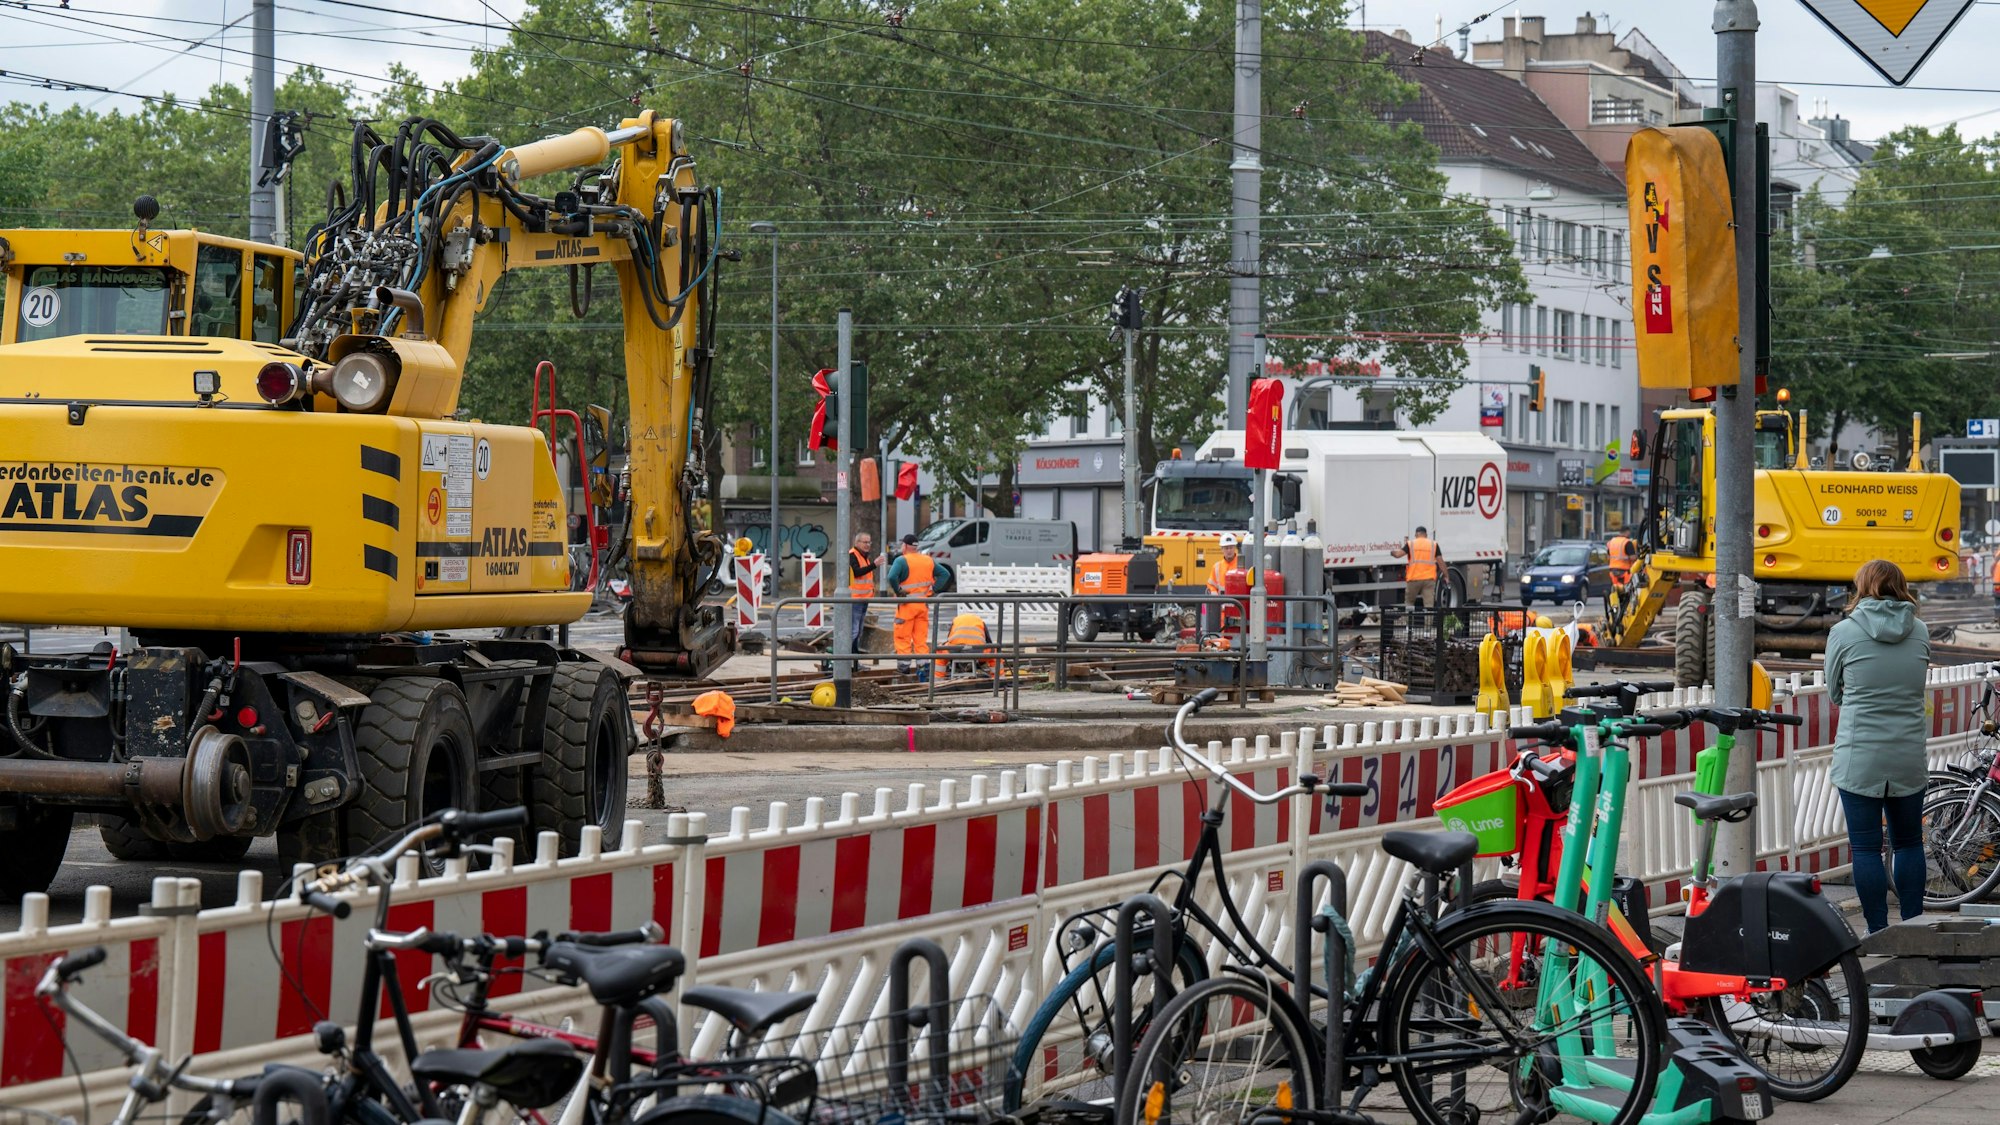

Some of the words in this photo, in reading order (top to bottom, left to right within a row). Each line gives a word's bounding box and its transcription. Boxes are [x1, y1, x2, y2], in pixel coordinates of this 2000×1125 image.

[555, 239, 582, 259] ATLAS
[38, 272, 77, 283] ATLAS
[82, 273, 158, 284] HANNOVER
[29, 294, 53, 319] 20
[478, 445, 489, 473] 20
[1441, 476, 1476, 508] KVB
[1820, 484, 1884, 494] LEONHARD
[1887, 485, 1918, 495] WEISS
[1, 482, 148, 522] ATLAS
[1826, 509, 1838, 521] 20
[1856, 508, 1887, 517] 500192
[481, 527, 527, 557] ATLAS
[1327, 543, 1366, 554] Gleisbearbeitung
[1811, 545, 1922, 564] LIEBHERR
[486, 561, 520, 576] 1604KZW
[1600, 790, 1614, 824] Bolt
[1470, 817, 1505, 832] Lime
[1566, 801, 1581, 837] Bolt
[1771, 930, 1790, 941] Uber
